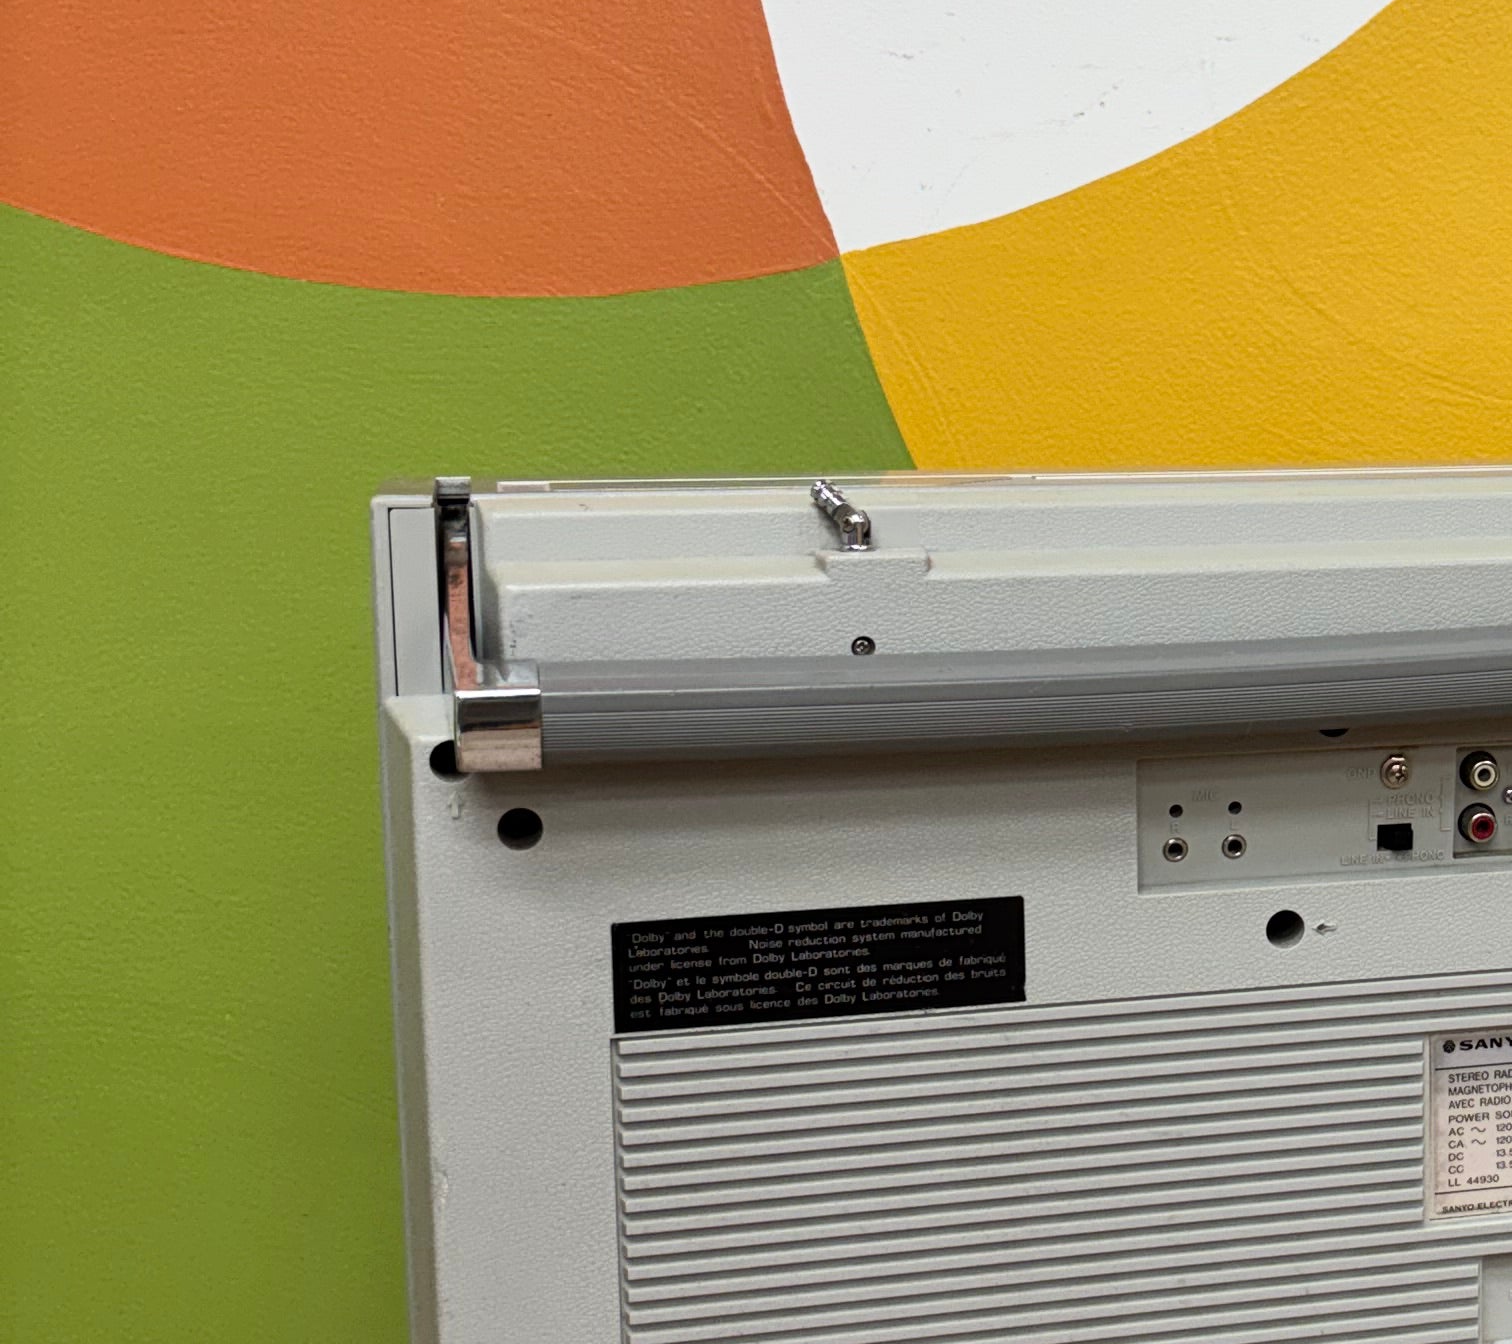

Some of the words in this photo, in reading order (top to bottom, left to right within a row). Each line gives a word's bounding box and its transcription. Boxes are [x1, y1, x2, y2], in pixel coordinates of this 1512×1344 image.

[1385, 807, 1416, 818] LINE
[1420, 806, 1433, 818] IN
[674, 931, 696, 942] and
[703, 929, 725, 939] the
[729, 923, 784, 937] double-D
[788, 921, 828, 935] symbol
[833, 921, 855, 930] are
[860, 914, 929, 929] trademarks
[934, 912, 947, 923] of
[952, 911, 984, 924] Dolby
[749, 938, 783, 950] Noise
[788, 934, 847, 947] reduction
[851, 931, 896, 944] system
[900, 925, 983, 940] manufactured
[629, 961, 665, 973] under
[671, 958, 713, 970] license
[718, 955, 748, 966] from
[753, 952, 785, 965] Dolby
[676, 976, 691, 987] et
[696, 975, 707, 986] le
[712, 971, 760, 986] symbole
[764, 966, 818, 981] double-D
[823, 965, 851, 977] sont
[856, 962, 878, 974] des
[883, 958, 934, 973] marques
[938, 956, 953, 968] de
[630, 994, 652, 1005] des
[658, 991, 692, 1004] Dolby
[795, 981, 812, 993] Ce
[817, 978, 857, 992] circuit
[862, 976, 877, 988] de
[944, 969, 966, 982] des
[970, 967, 1007, 980] bruits
[630, 1008, 651, 1019] est
[714, 1002, 744, 1013] sous
[797, 994, 819, 1006] des
[824, 993, 857, 1006] Dolby
[1448, 1070, 1490, 1084] STEREO
[1448, 1097, 1476, 1110] AVEC
[1479, 1094, 1512, 1107] RADIO
[1448, 1110, 1491, 1125] POWER
[1448, 1126, 1465, 1137] AC
[1448, 1151, 1465, 1163] DC
[1448, 1164, 1465, 1175] CC
[1448, 1176, 1462, 1188] LL
[1466, 1173, 1500, 1185] 44930
[1441, 1202, 1475, 1214] SANYO
